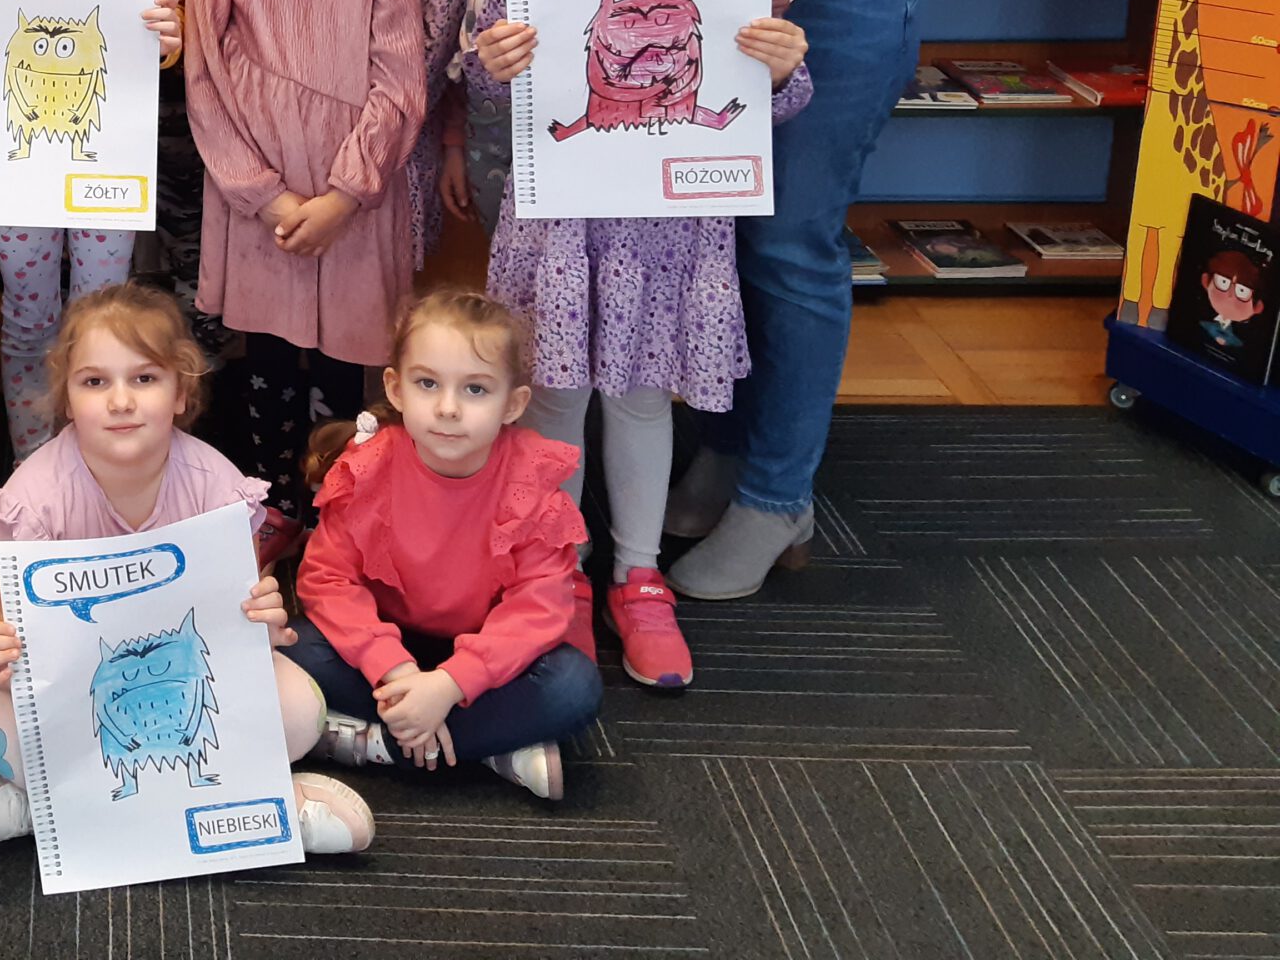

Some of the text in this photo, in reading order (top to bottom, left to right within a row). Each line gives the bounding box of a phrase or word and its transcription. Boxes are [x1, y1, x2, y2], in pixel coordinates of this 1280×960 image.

[674, 167, 752, 185] RÓŻOWY
[84, 183, 130, 200] ŻÓŁTY
[53, 558, 157, 594] SMUTEK
[198, 812, 279, 837] NIEBIESKI
